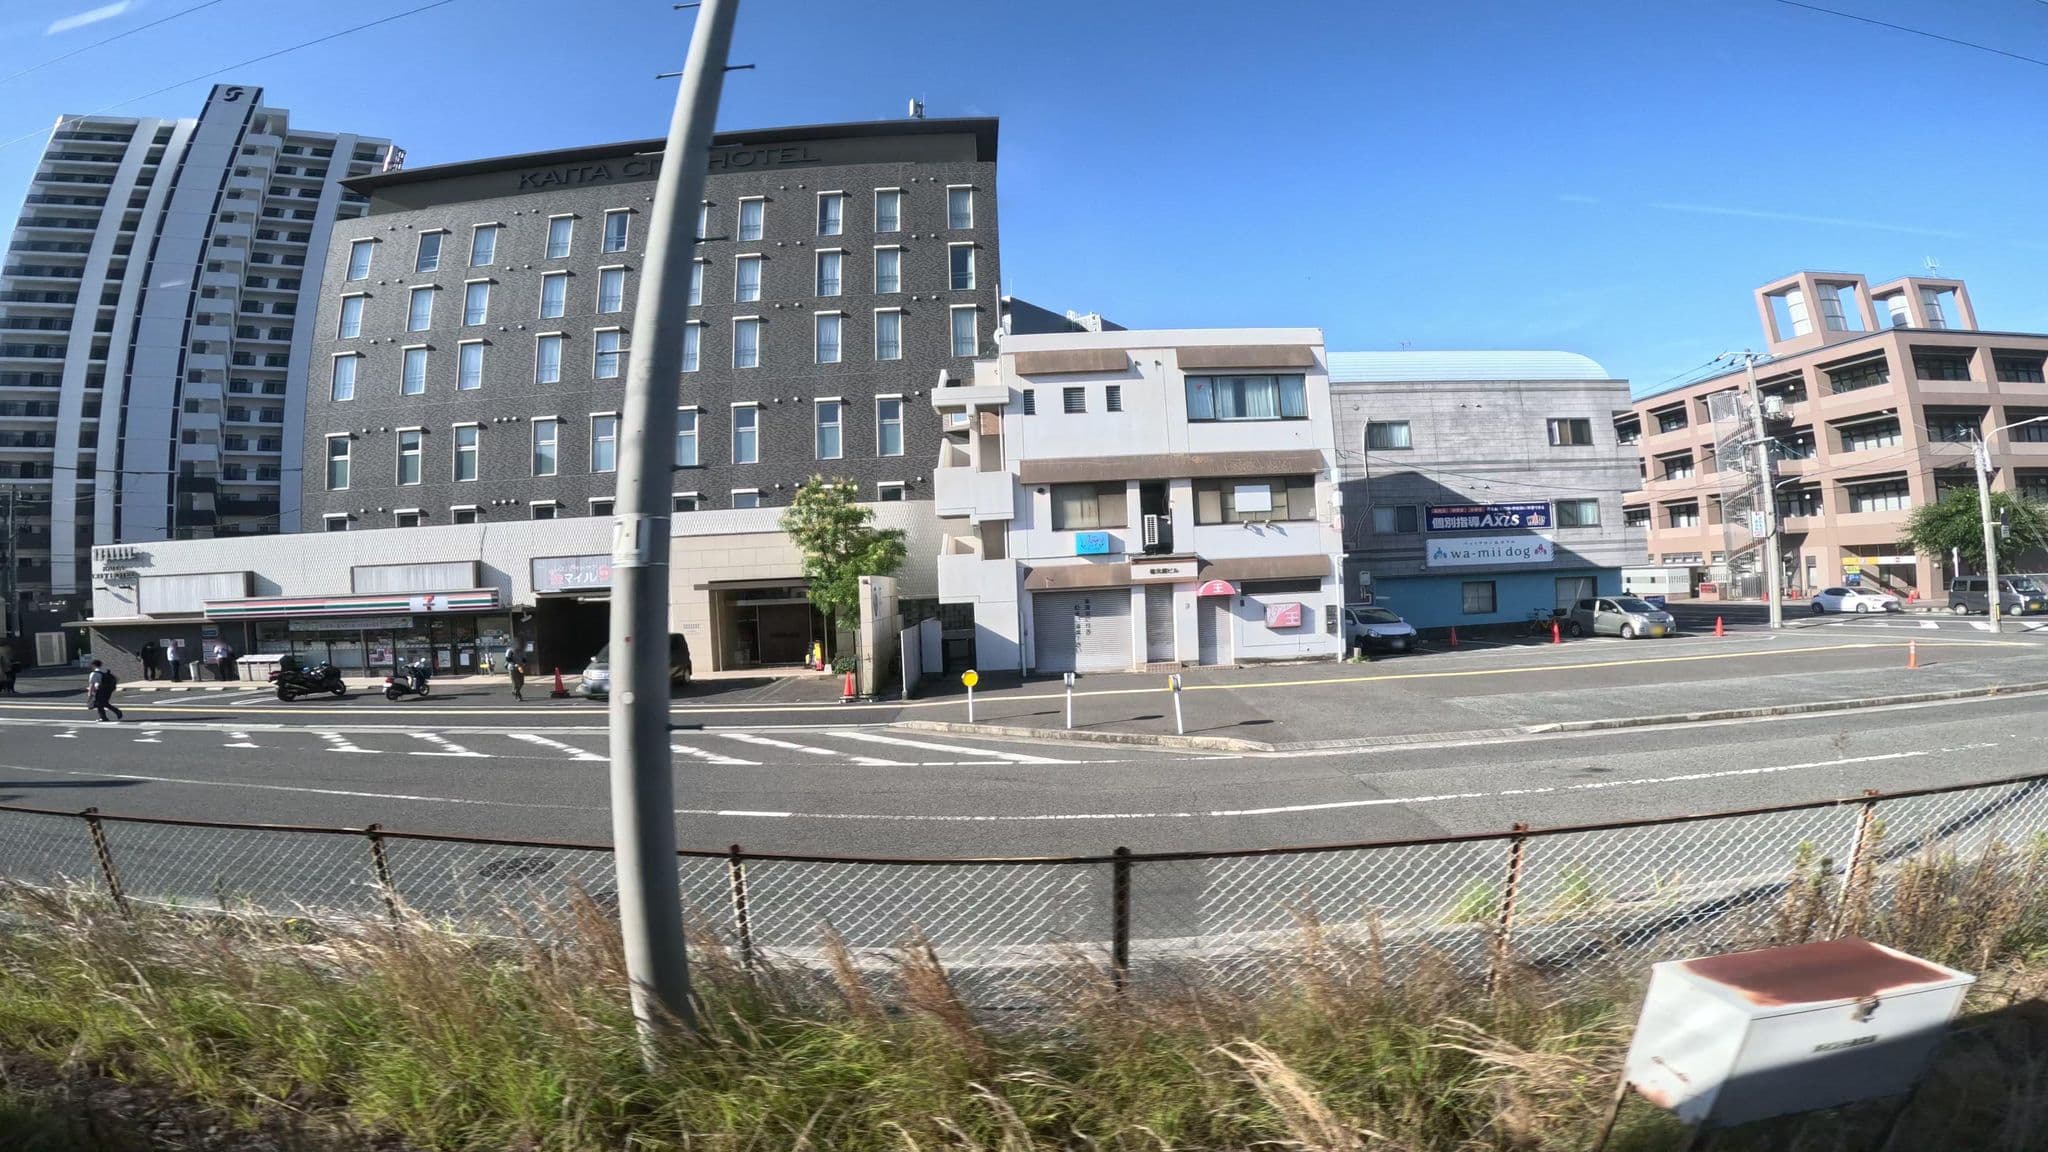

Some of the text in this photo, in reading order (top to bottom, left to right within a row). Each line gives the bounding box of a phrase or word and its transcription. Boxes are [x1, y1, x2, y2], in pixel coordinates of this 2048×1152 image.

[519, 162, 610, 189] KAITA
[709, 145, 820, 169] HOTEL
[1431, 516, 1481, 529] 個別指導
[1505, 545, 1531, 560] dog
